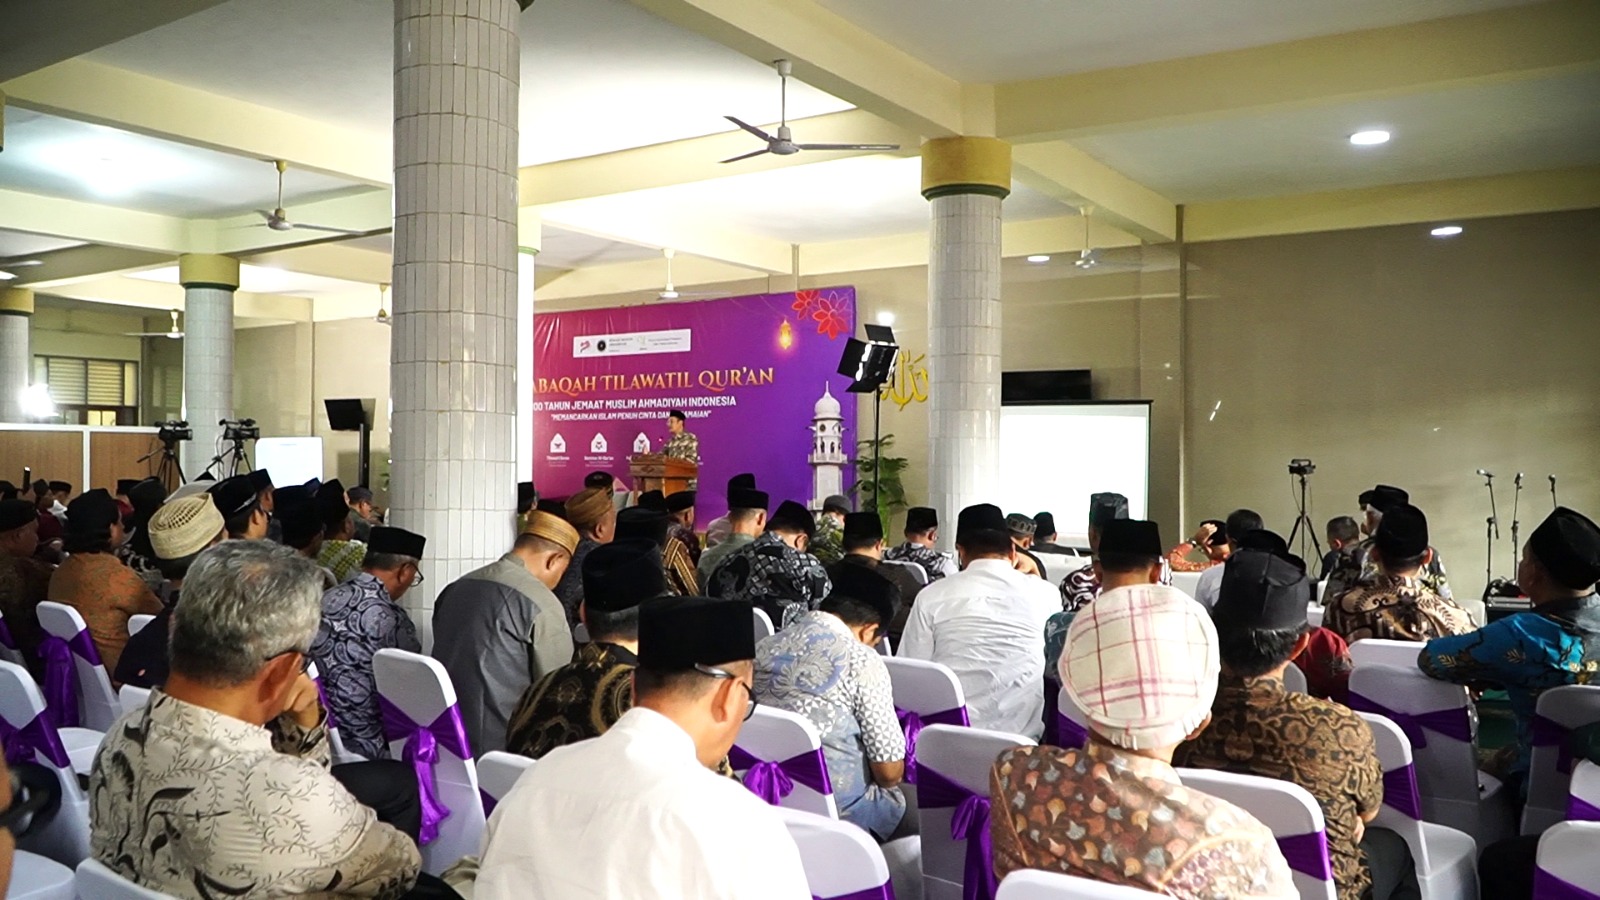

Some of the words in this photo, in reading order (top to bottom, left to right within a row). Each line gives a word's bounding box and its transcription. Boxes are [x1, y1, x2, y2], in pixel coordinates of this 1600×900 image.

[600, 371, 694, 391] TILAWATIL
[544, 400, 571, 411] TAHUN
[571, 399, 604, 411] JEMAAT
[605, 399, 637, 410] MUSLIM
[638, 397, 687, 409] AHMADIYAH
[688, 395, 737, 407] INDONESIA
[599, 412, 618, 420] ISLAM
[617, 411, 638, 419] PENUH
[638, 411, 657, 419] CINTA
[657, 411, 671, 419] DAN
